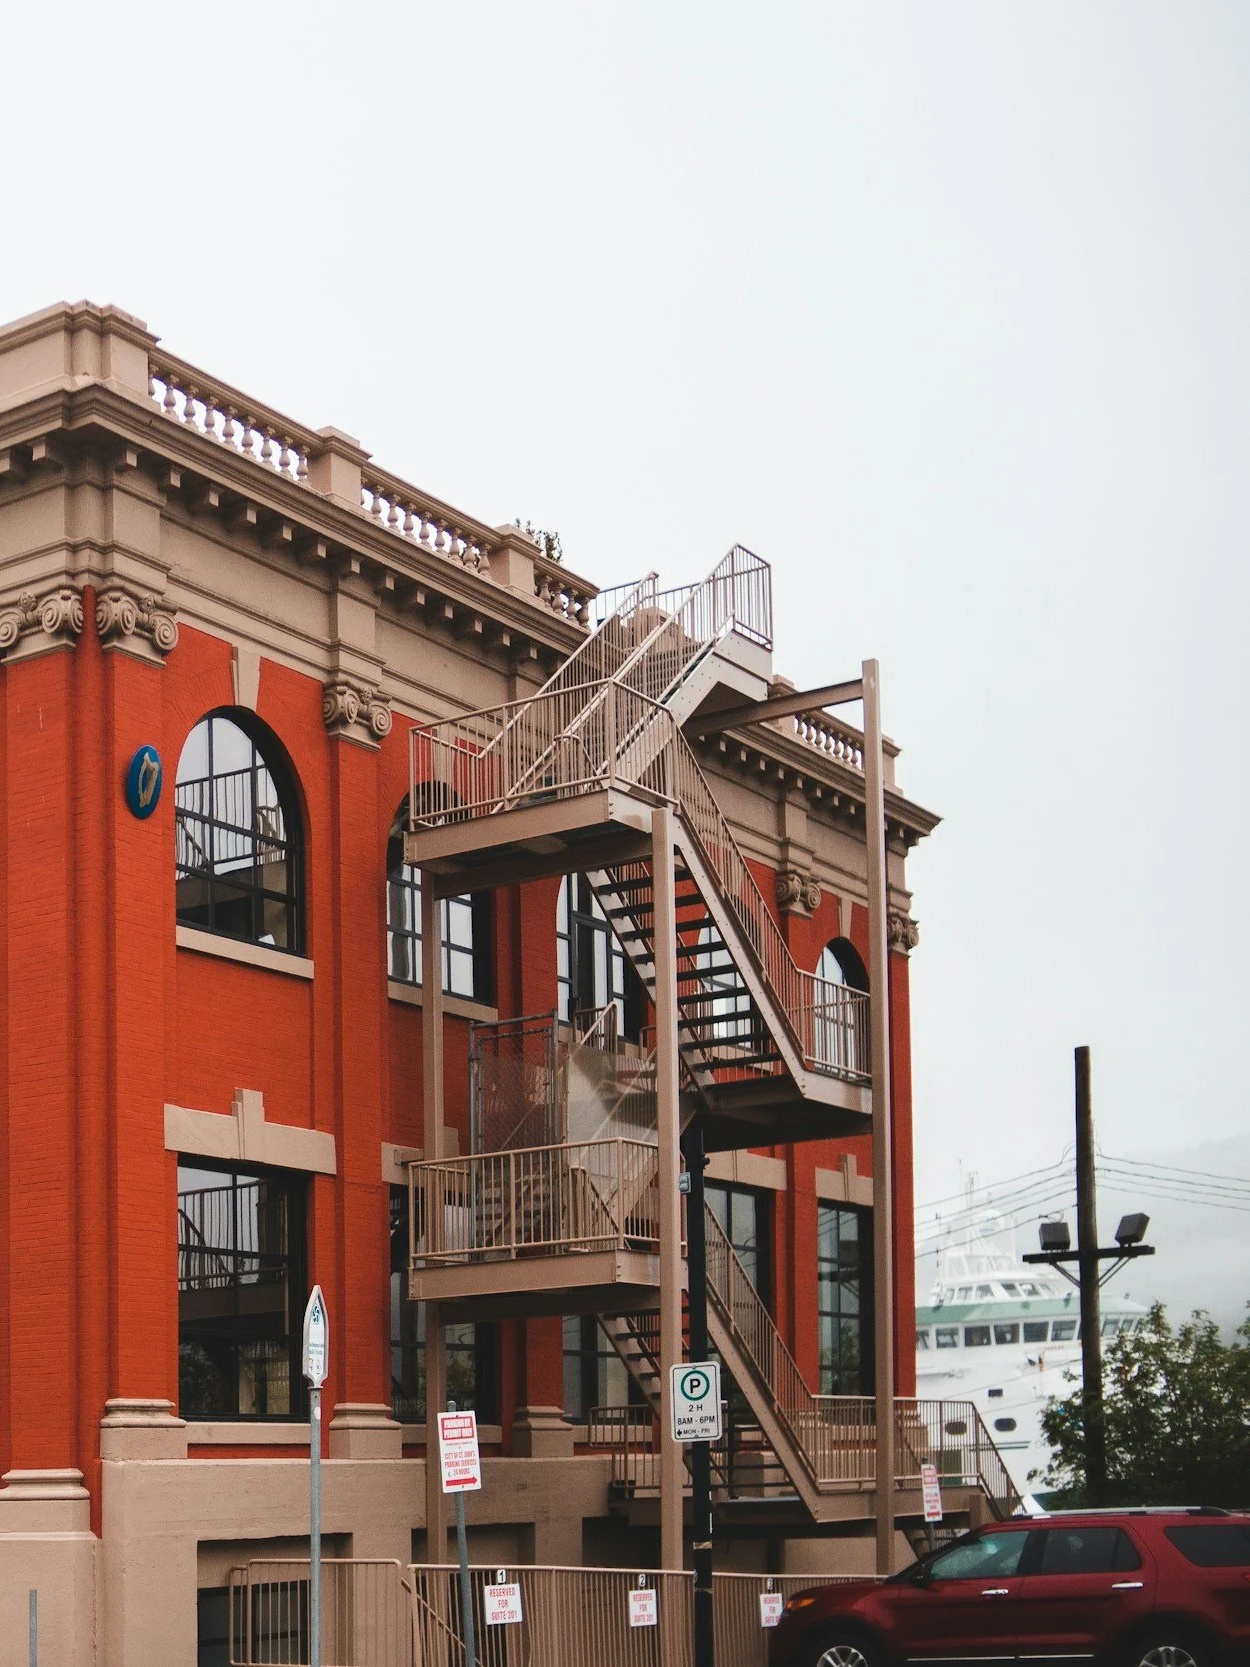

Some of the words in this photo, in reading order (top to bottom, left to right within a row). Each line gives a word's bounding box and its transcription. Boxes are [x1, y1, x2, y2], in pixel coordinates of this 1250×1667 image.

[689, 1378, 701, 1394] P
[688, 1404, 694, 1412] 2
[696, 1404, 703, 1412] H
[677, 1417, 693, 1426] 8AM
[699, 1415, 716, 1424] 6PM
[444, 1452, 453, 1460] CITY
[458, 1467, 471, 1475] HOURS
[499, 1570, 504, 1582] 1
[640, 1575, 645, 1586] 2
[489, 1587, 515, 1597] RESERVED
[632, 1593, 653, 1602] RESERVED
[498, 1599, 508, 1608] FOR
[639, 1603, 647, 1611] FOR
[491, 1611, 506, 1621] SUITE
[507, 1610, 518, 1620] 201
[634, 1614, 646, 1623] SUITE
